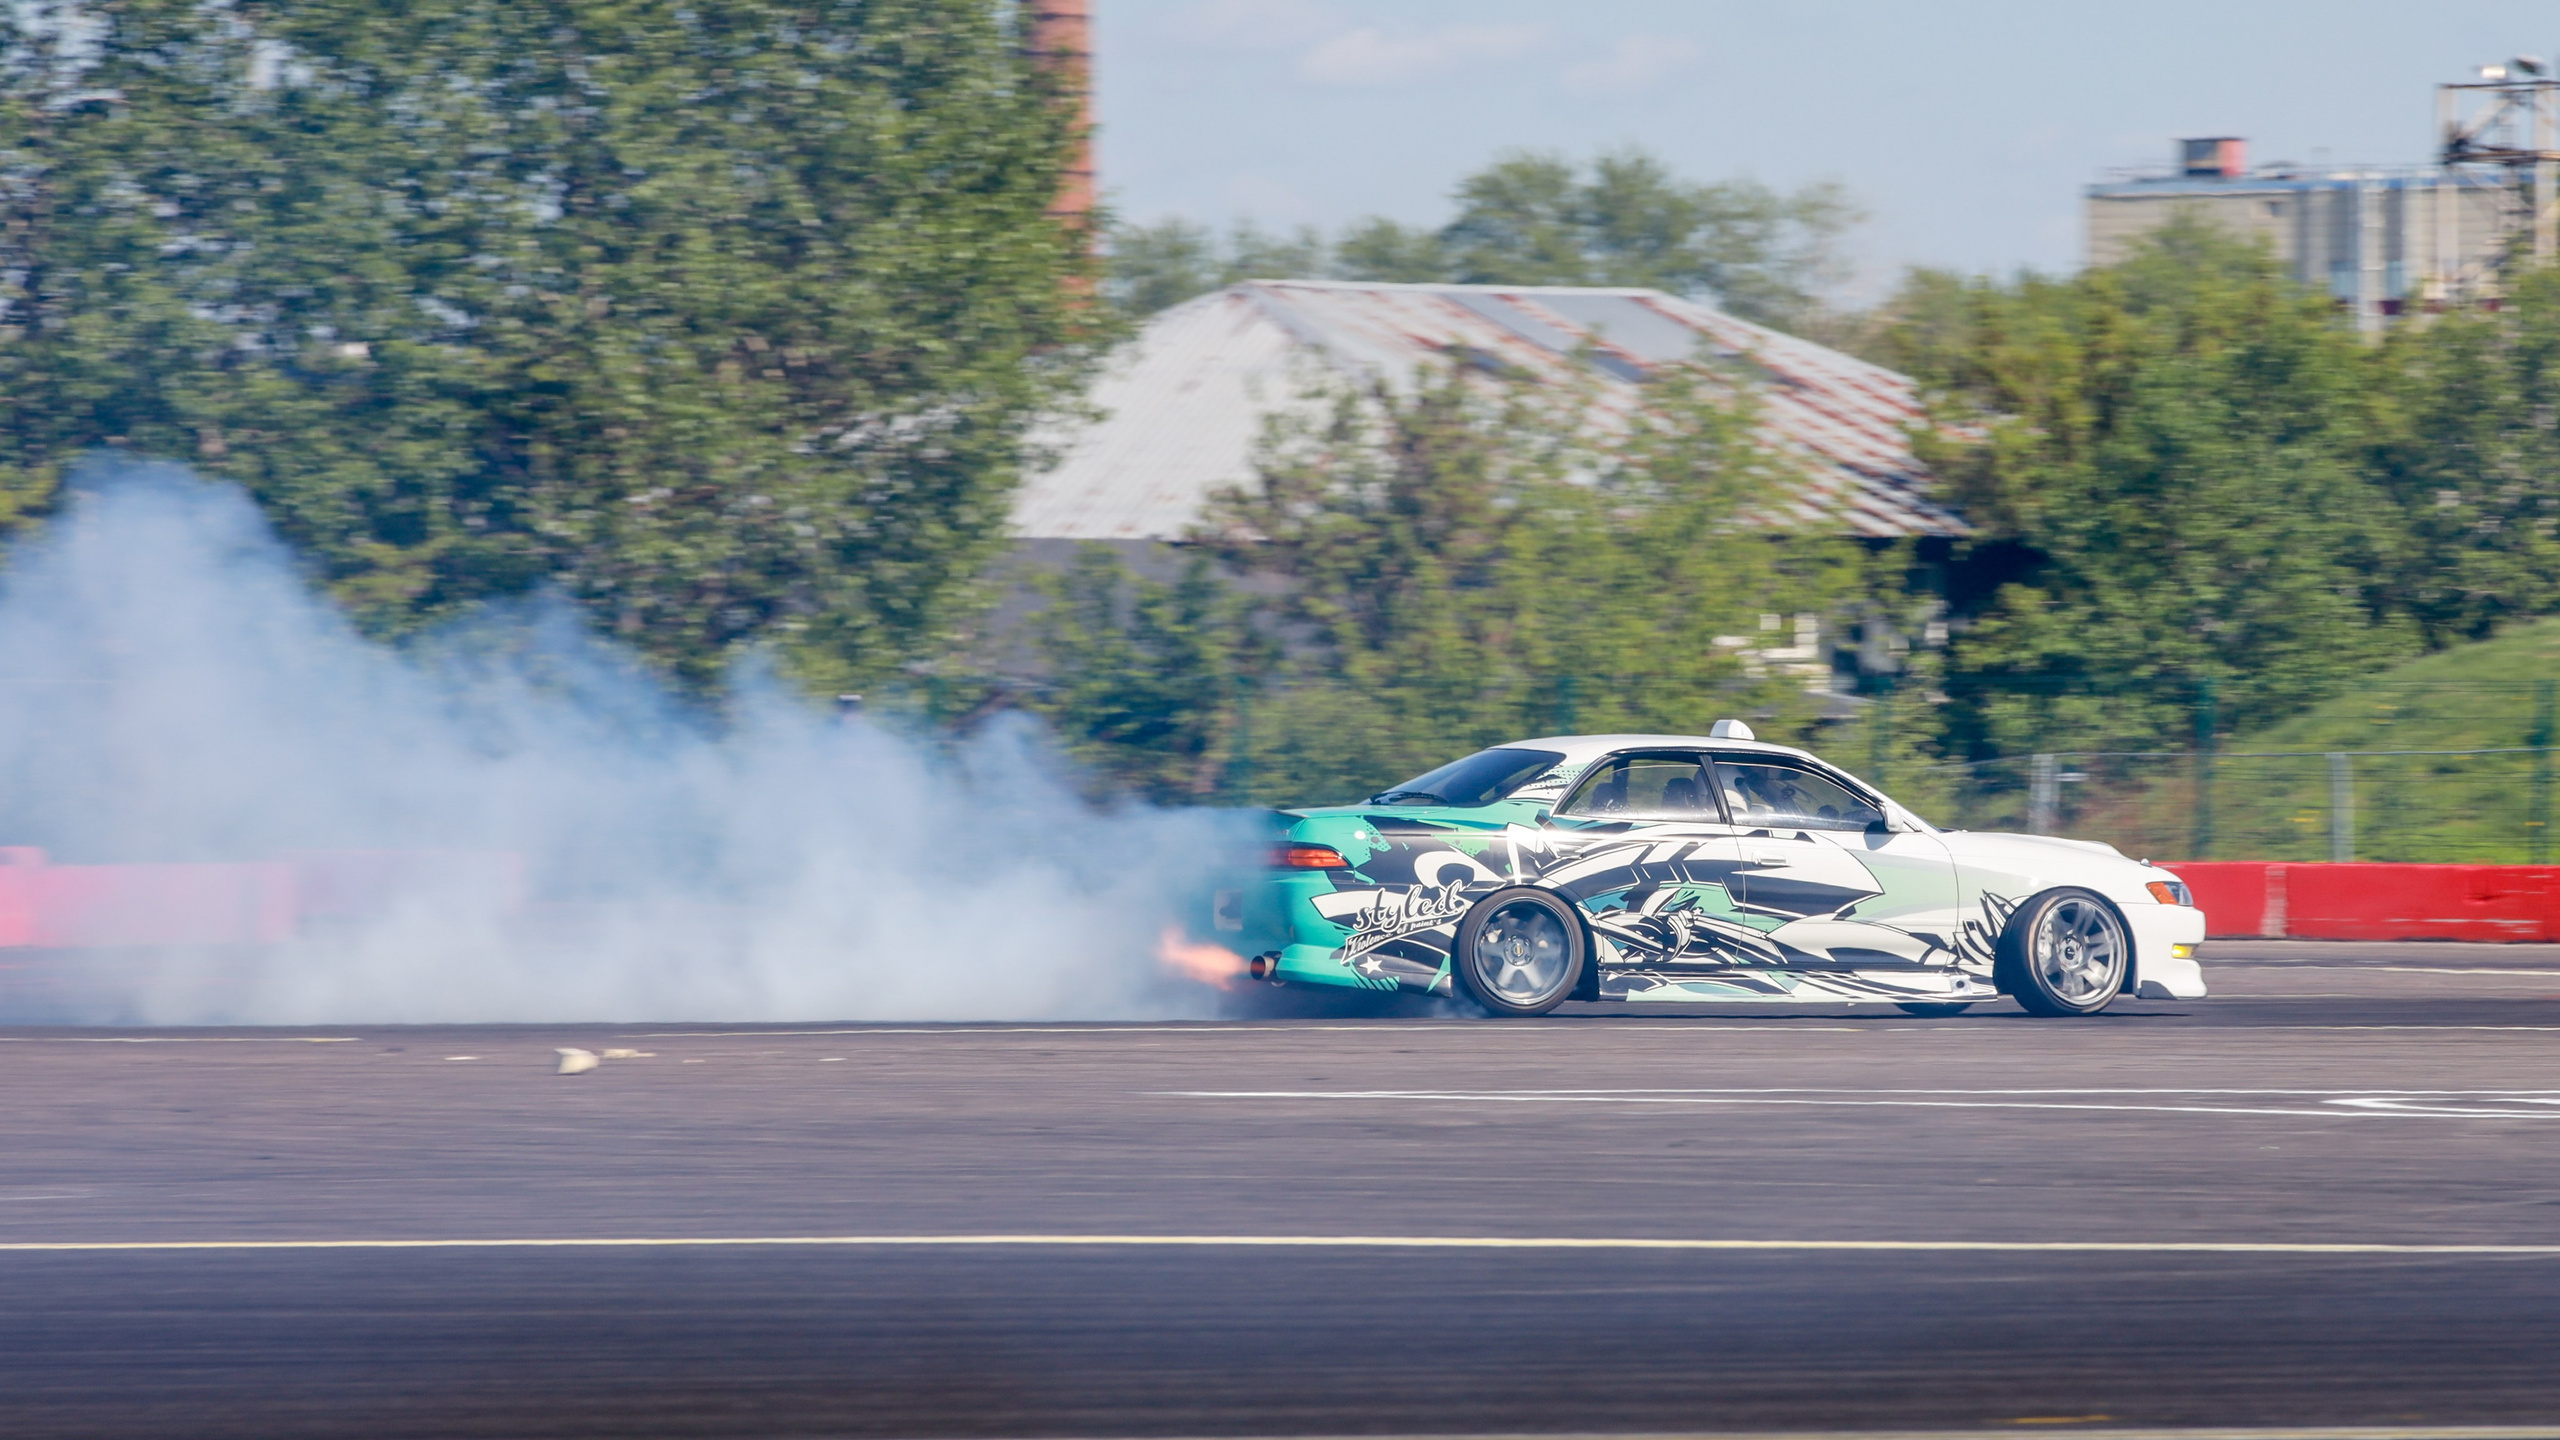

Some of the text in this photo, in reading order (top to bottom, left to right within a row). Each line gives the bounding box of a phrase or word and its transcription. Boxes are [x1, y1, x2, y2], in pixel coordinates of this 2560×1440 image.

[1353, 879, 1463, 932] styled
[1348, 932, 1393, 956] Violence
[1397, 922, 1407, 934] of
